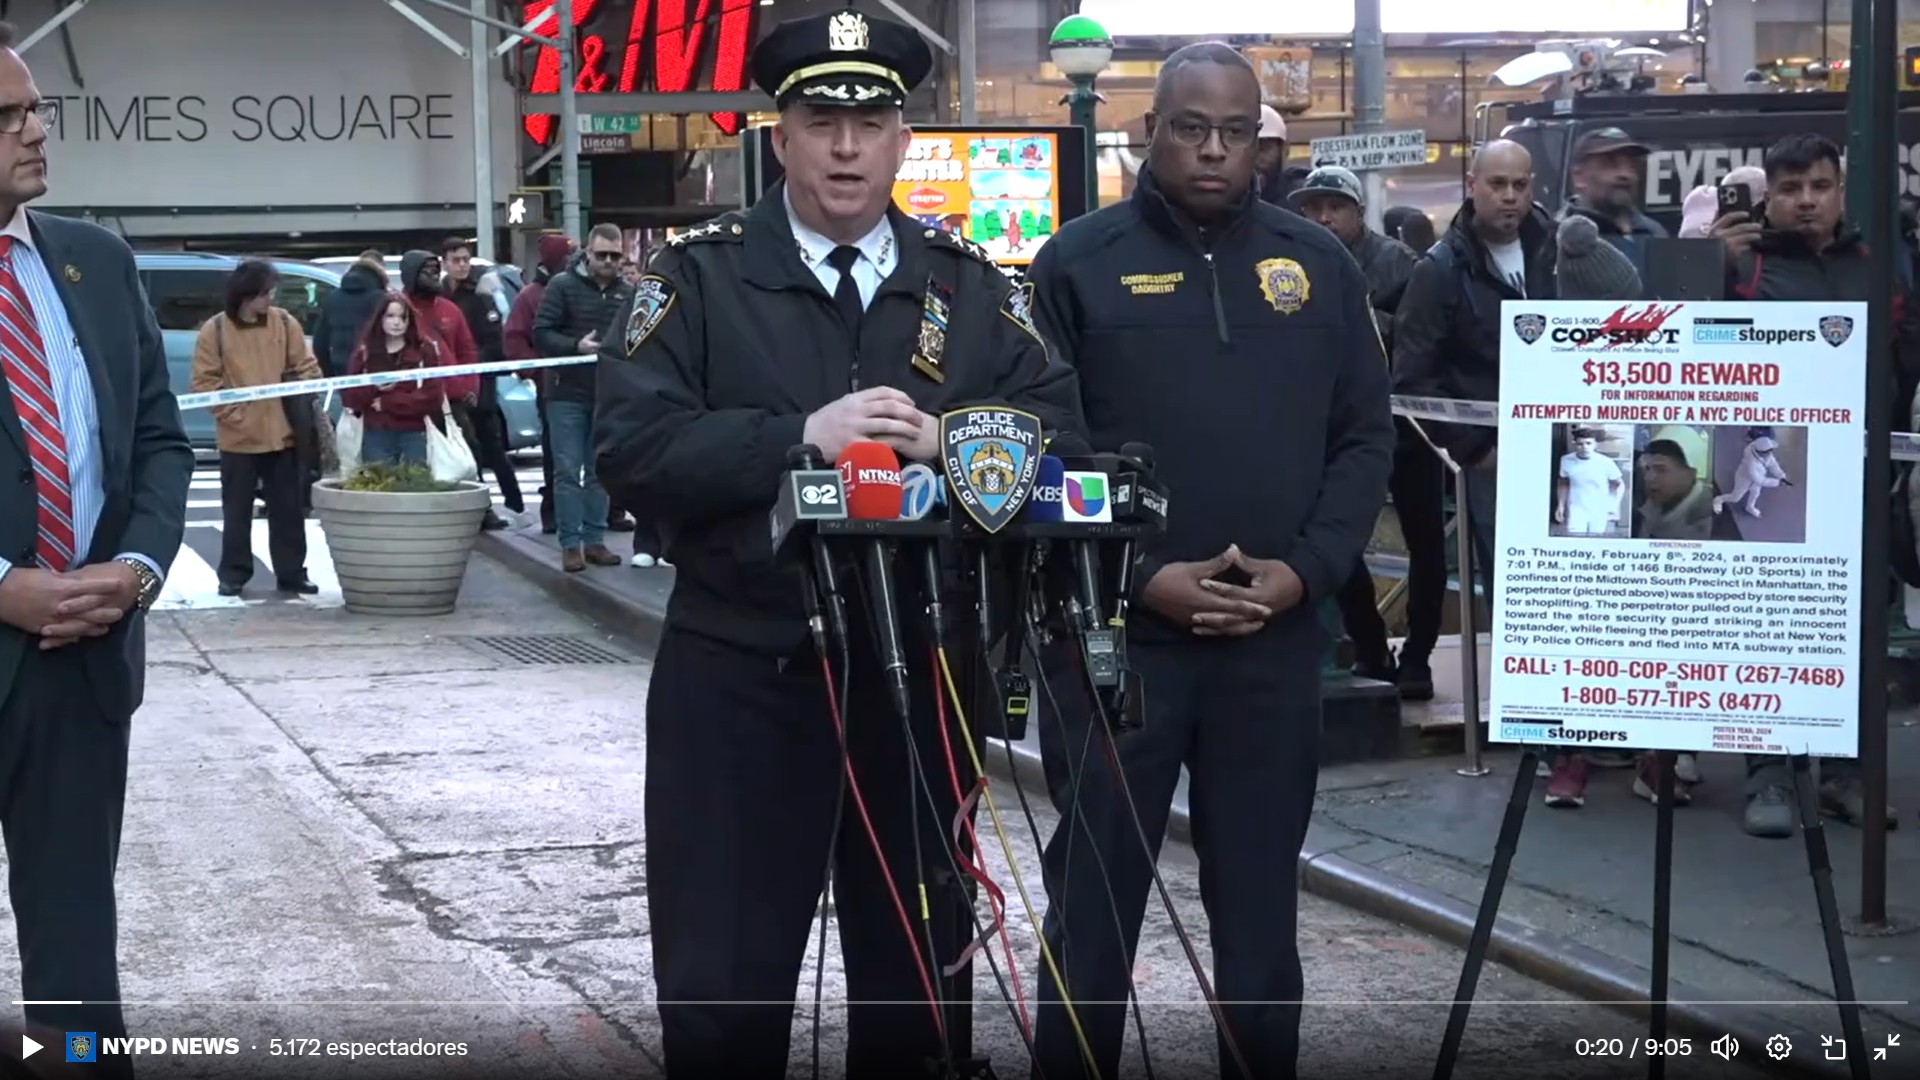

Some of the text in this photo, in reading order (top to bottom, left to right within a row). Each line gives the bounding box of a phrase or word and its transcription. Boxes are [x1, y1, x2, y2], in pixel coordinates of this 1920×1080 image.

[42, 94, 453, 142] TIMES SQUARE
[593, 117, 605, 131] W
[610, 117, 625, 131] 42
[583, 137, 625, 148] Lincoln
[1313, 132, 1424, 154] PEDESTRIAN FLOW ZONE
[1361, 149, 1424, 166] KEEP MOVING
[1551, 316, 1573, 325] Call
[1696, 329, 1738, 341] CRIME
[1739, 326, 1816, 345] stoppers
[1582, 358, 1780, 387] $13,500 REWARD
[1601, 389, 1759, 402] FOR INFORMATION REGARDING
[968, 412, 1015, 426] POLICE
[1512, 404, 1851, 423] ATTEMPTED MURDER OF A NYC POLICE OFFICER
[949, 424, 1035, 446] DEPARTMENT
[858, 469, 900, 482] NTN24
[949, 457, 978, 506] CITY OF
[1005, 455, 1035, 512] NEW YORK
[1032, 486, 1062, 502] KBS
[1507, 547, 1525, 556] On
[1532, 548, 1595, 560] Thursday,
[1602, 550, 1660, 562] February
[1692, 552, 1726, 563] 2024,
[1733, 554, 1745, 562] at
[1752, 555, 1848, 567] approximately
[1507, 560, 1848, 578] 7:01 P.M., inside of 1466 Broadway (JD Sports) in the
[1506, 574, 1848, 591] confines of the Midtown South Precinct in Manhattan, the
[1506, 586, 1847, 605] perpetrator (pictured above) was stopped by store security
[1506, 598, 1847, 616] for shoplifting. The perpetrator pulled out a gun and shot
[1505, 610, 1847, 629] toward the store security guard striking an innocent
[1505, 622, 1846, 642] bystander, while fleeing the perpetrator shot at New York
[1504, 634, 1846, 655] City Police Officers and fled into MTA subway station.
[1504, 656, 1845, 689] CALL: 1-800-COP-SHOT (267-7468)
[1665, 681, 1678, 689] OR
[1562, 686, 1781, 713] 1-800-577-TIPS (8477)
[1503, 726, 1628, 742] CRIME stoppers
[1713, 726, 1735, 734] POSTER
[1713, 734, 1735, 742] POSTER
